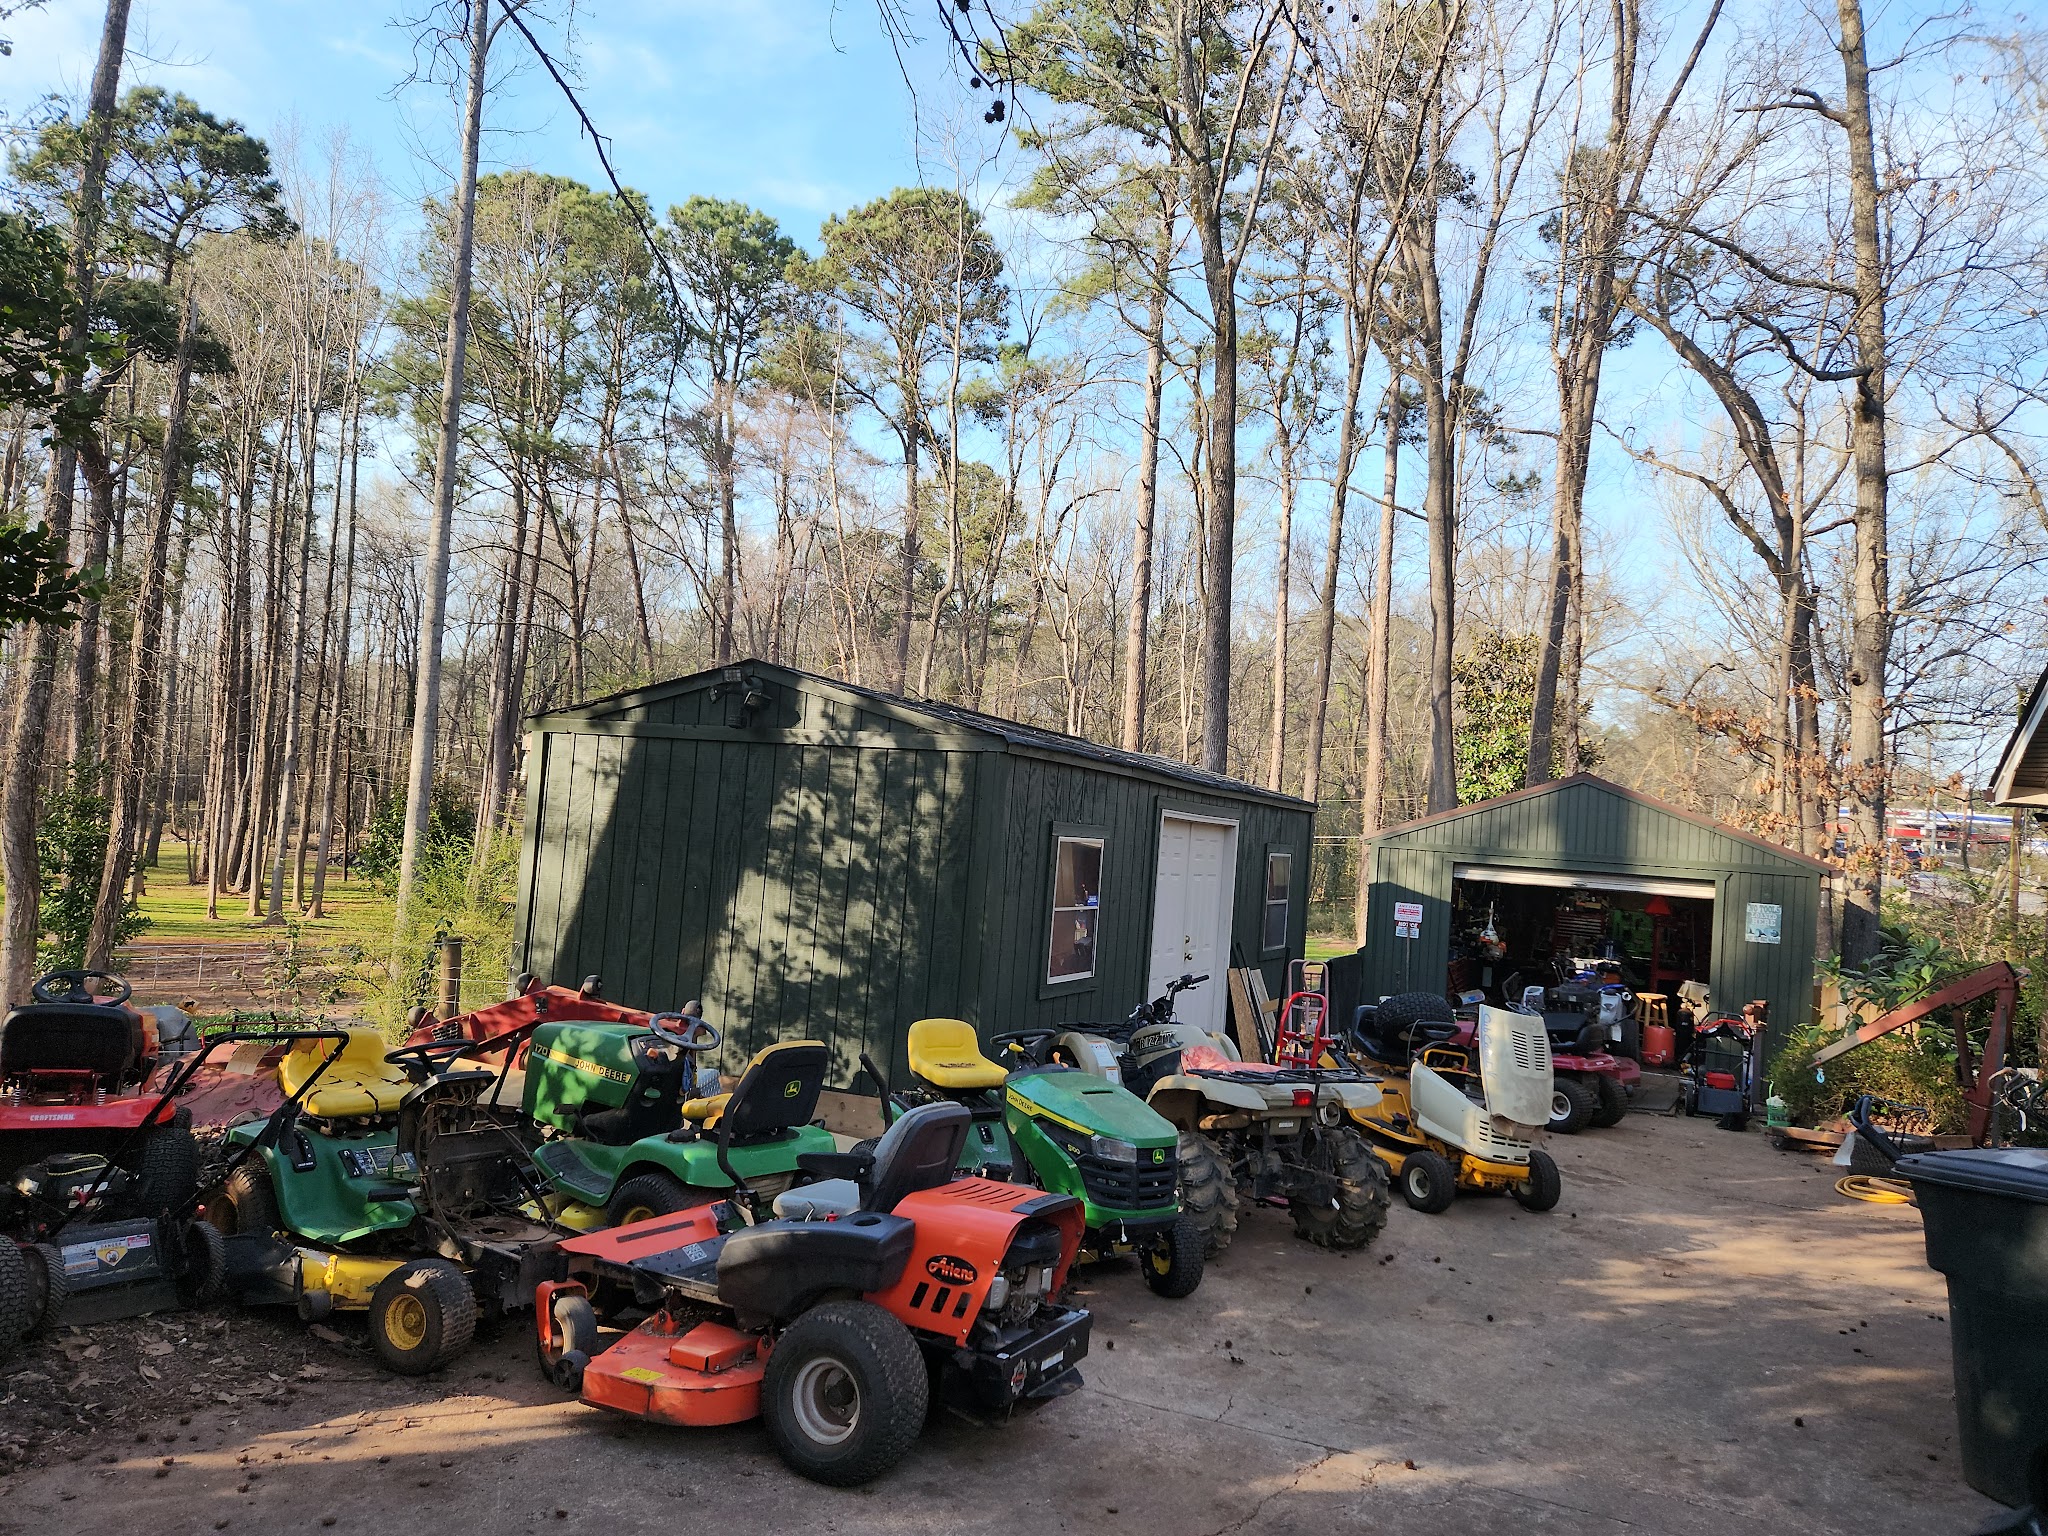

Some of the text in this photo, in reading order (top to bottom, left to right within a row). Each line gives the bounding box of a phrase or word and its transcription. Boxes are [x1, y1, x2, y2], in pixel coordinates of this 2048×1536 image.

[1760, 905, 1781, 914] TOOLS
[1752, 918, 1776, 926] HERE
[534, 1043, 548, 1056] 170
[575, 1059, 627, 1082] JOHN DEERE
[1008, 1093, 1033, 1112] JOHN DEERE
[29, 1113, 75, 1121] CRAFTSMAN
[928, 1256, 975, 1283] Ariens
